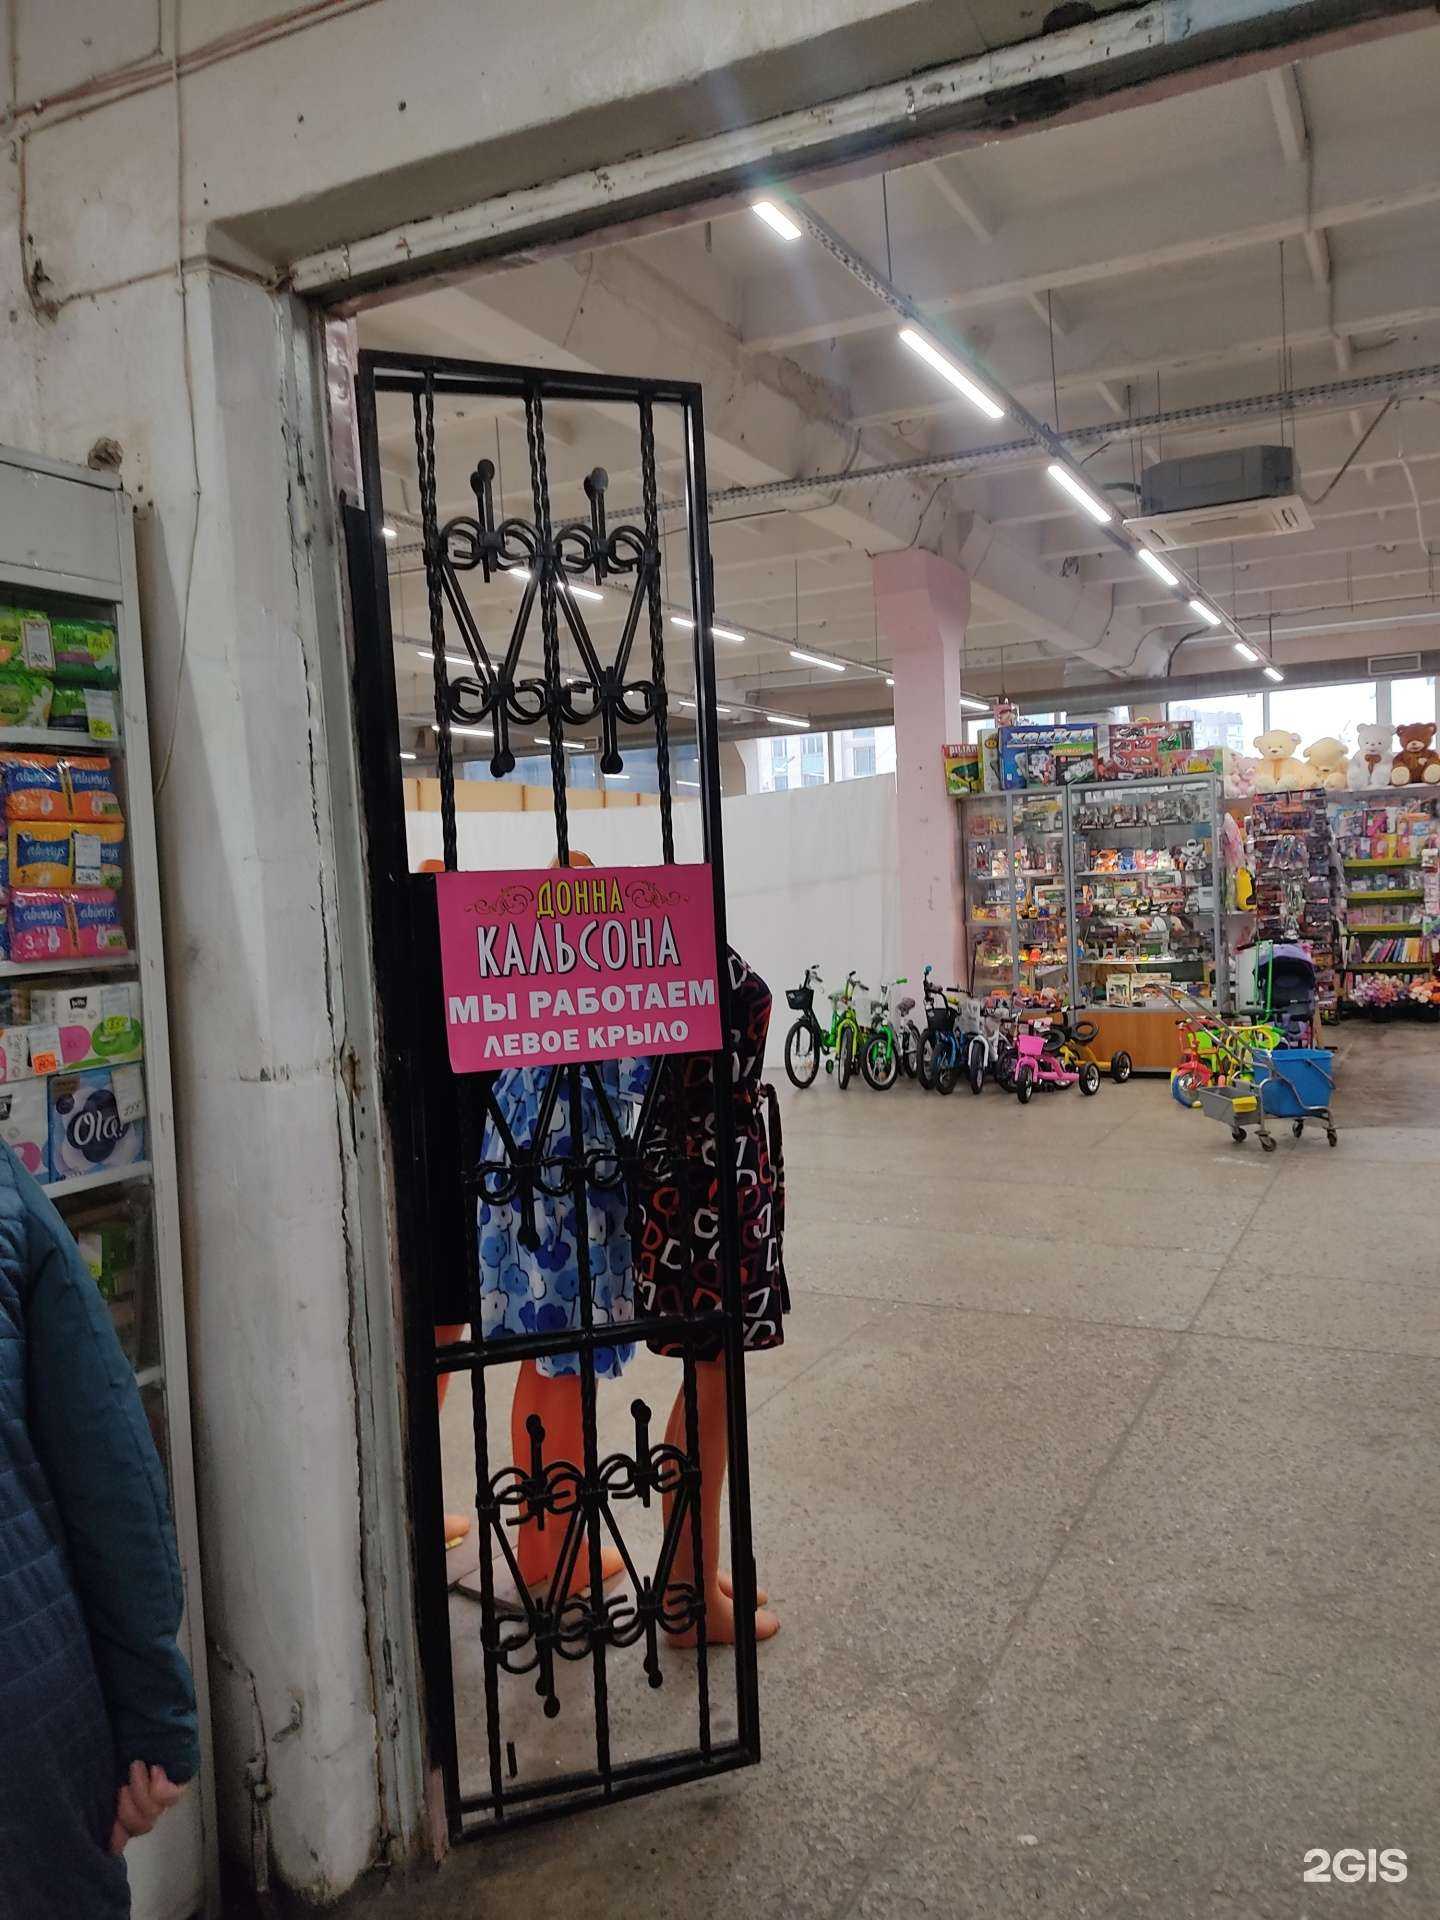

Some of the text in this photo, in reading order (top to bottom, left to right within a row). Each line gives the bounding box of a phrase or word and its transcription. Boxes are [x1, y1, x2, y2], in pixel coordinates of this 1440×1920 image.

[537, 877, 625, 919] ДОННА
[477, 915, 681, 978] КАЛЬСОНА
[449, 979, 716, 1025] МЫ РАБОТАЕМ
[483, 1020, 690, 1058] ЛЕВОЕ КРЫЛО
